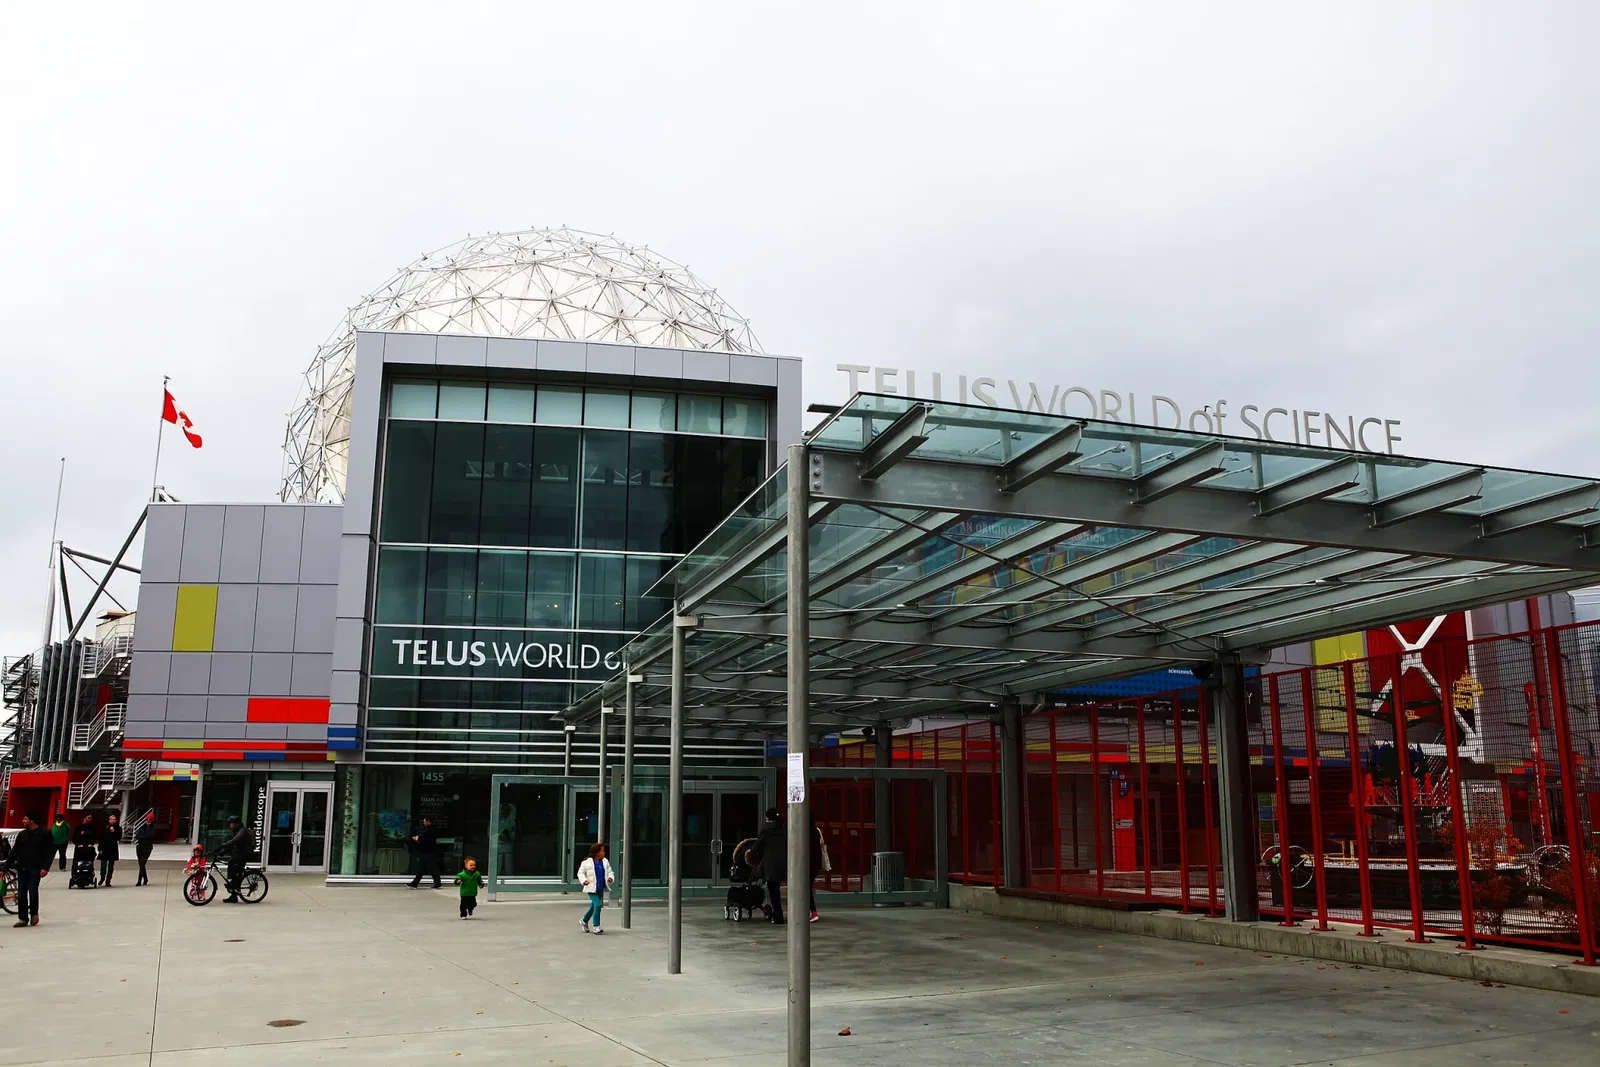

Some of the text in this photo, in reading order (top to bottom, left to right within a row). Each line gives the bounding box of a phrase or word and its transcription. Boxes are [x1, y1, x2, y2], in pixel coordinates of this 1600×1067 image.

[836, 363, 1401, 455] TELUS WORLD of SCIENCE
[960, 521, 973, 533] AN
[392, 639, 486, 667] TELUS
[492, 642, 601, 669] WORLD
[421, 772, 444, 781] 1455
